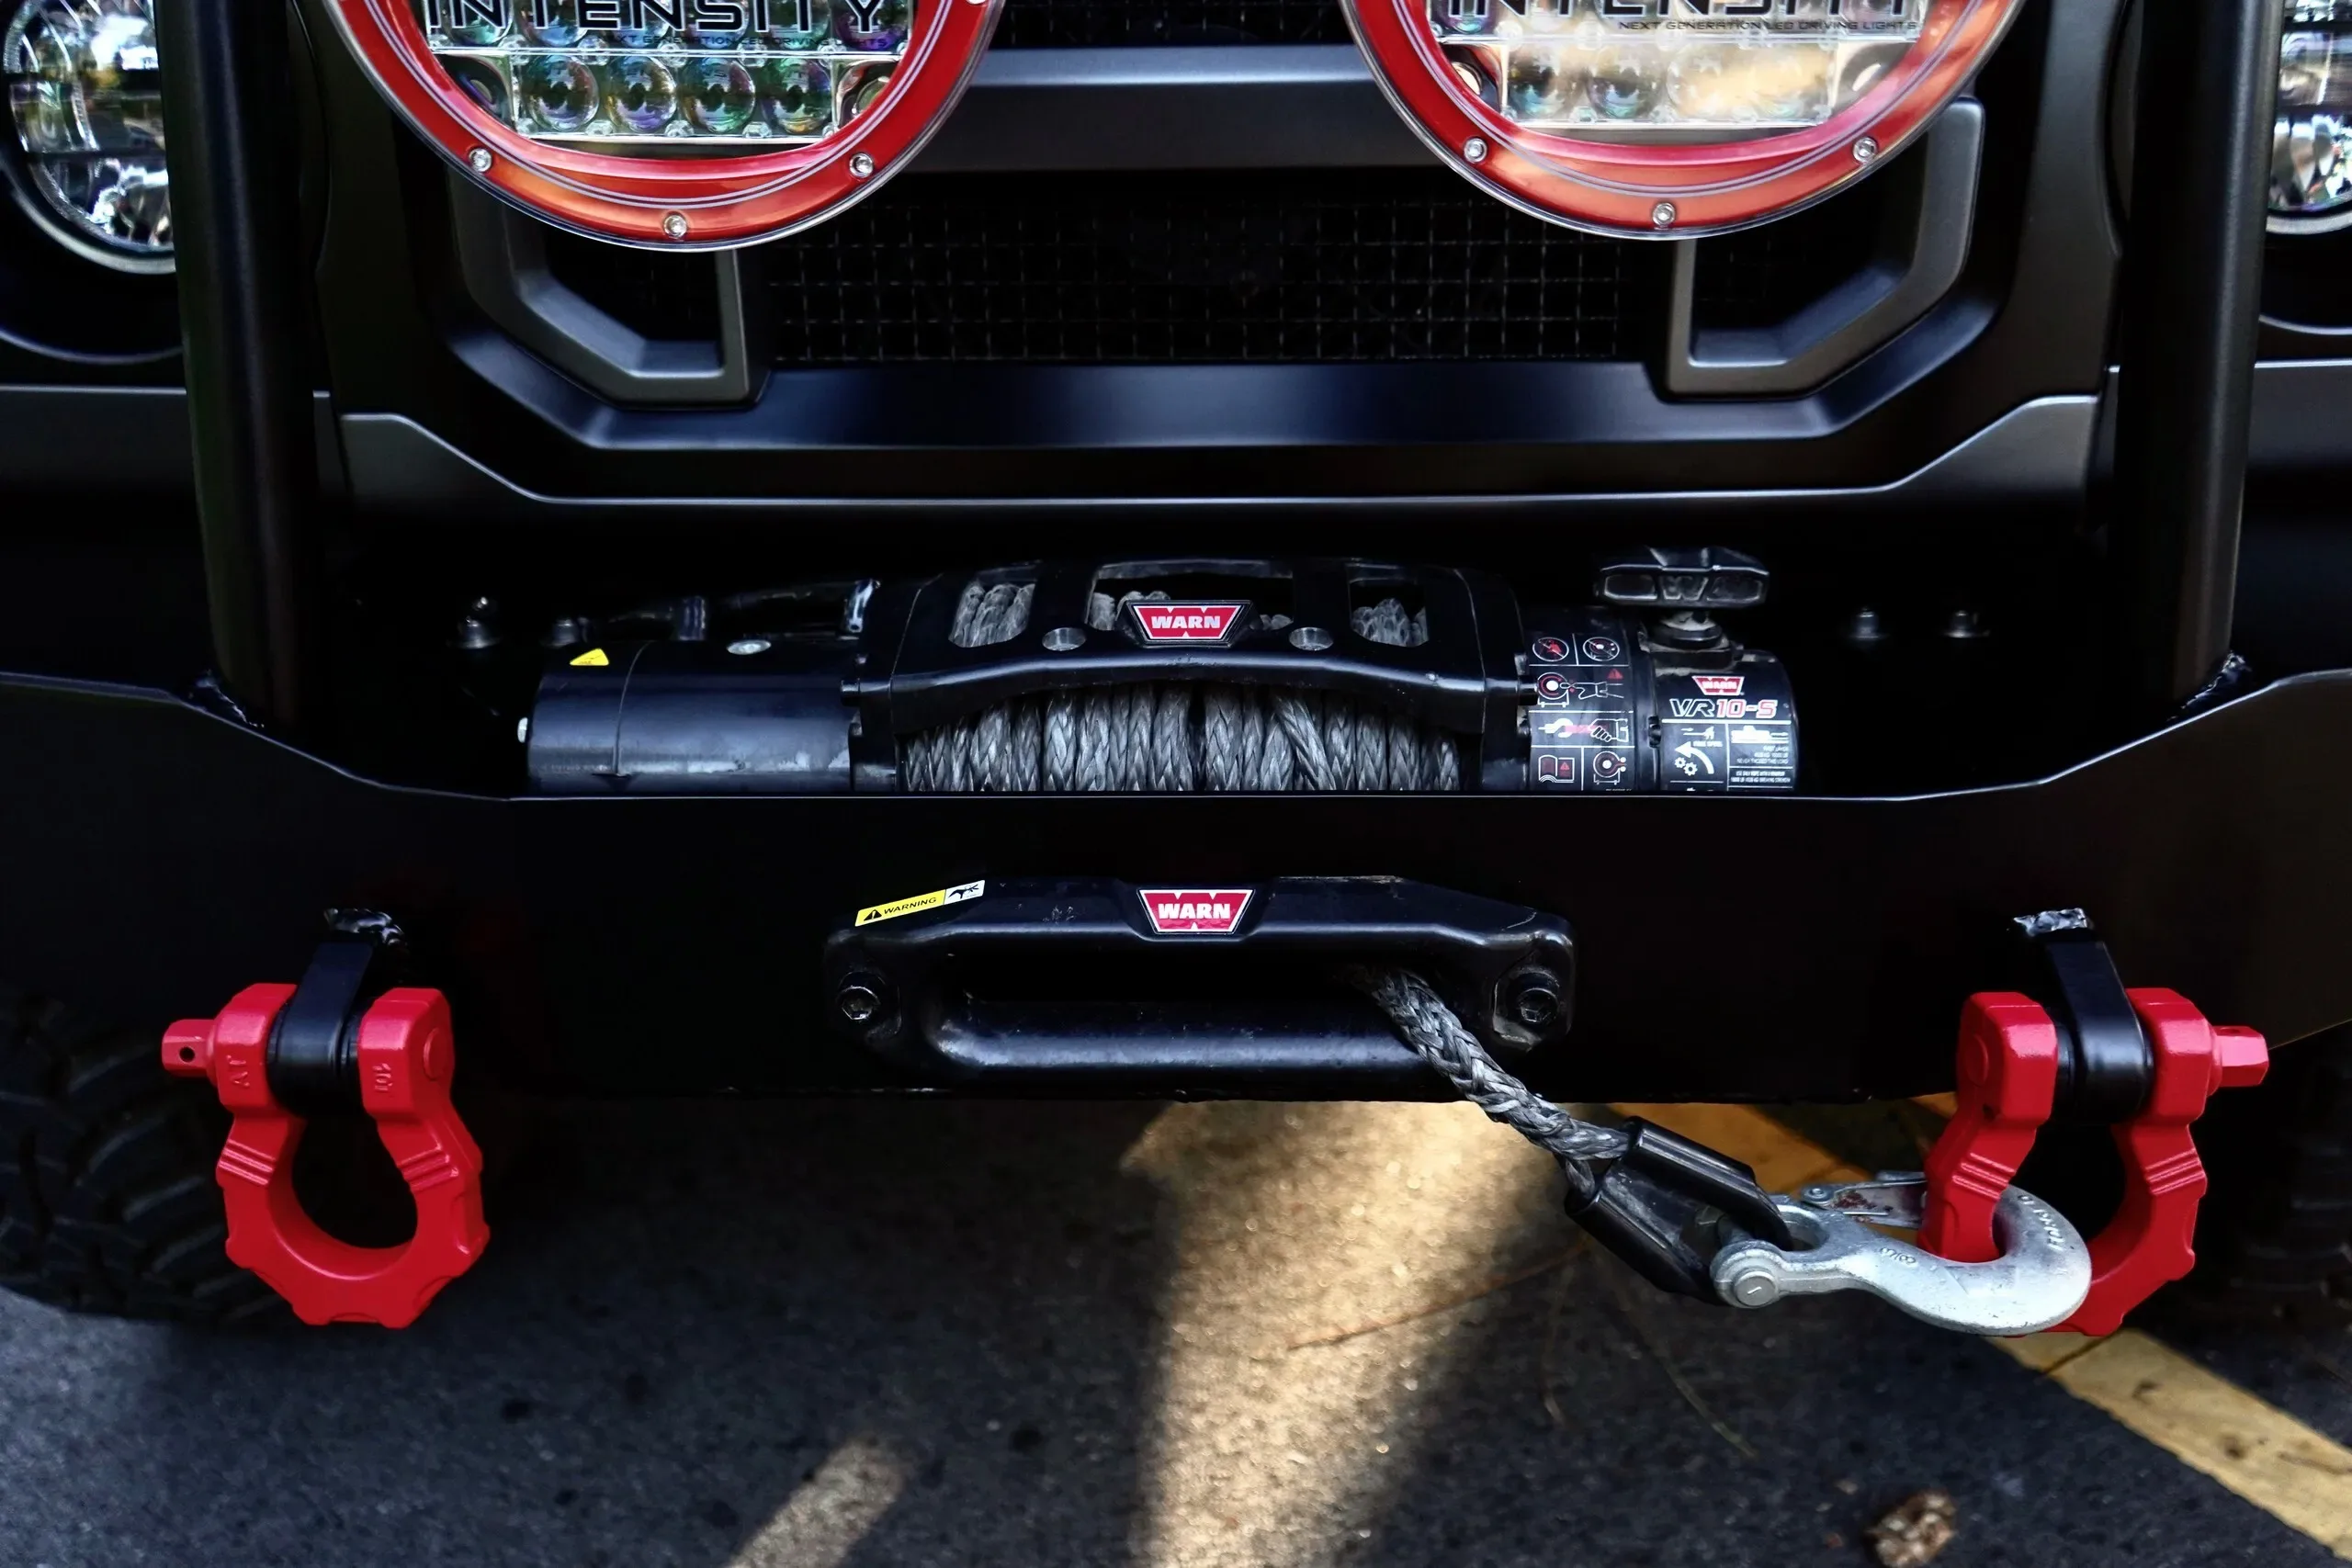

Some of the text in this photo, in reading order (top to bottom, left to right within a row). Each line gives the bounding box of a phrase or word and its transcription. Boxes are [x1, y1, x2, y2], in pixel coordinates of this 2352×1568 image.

[1619, 21, 1917, 29] NEXT GENERATION LED DRIVING LIGHTS
[1150, 615, 1221, 629] WARN
[1668, 698, 1779, 719] VR10-S
[883, 897, 937, 915] WARNING
[1158, 903, 1231, 919] WARN
